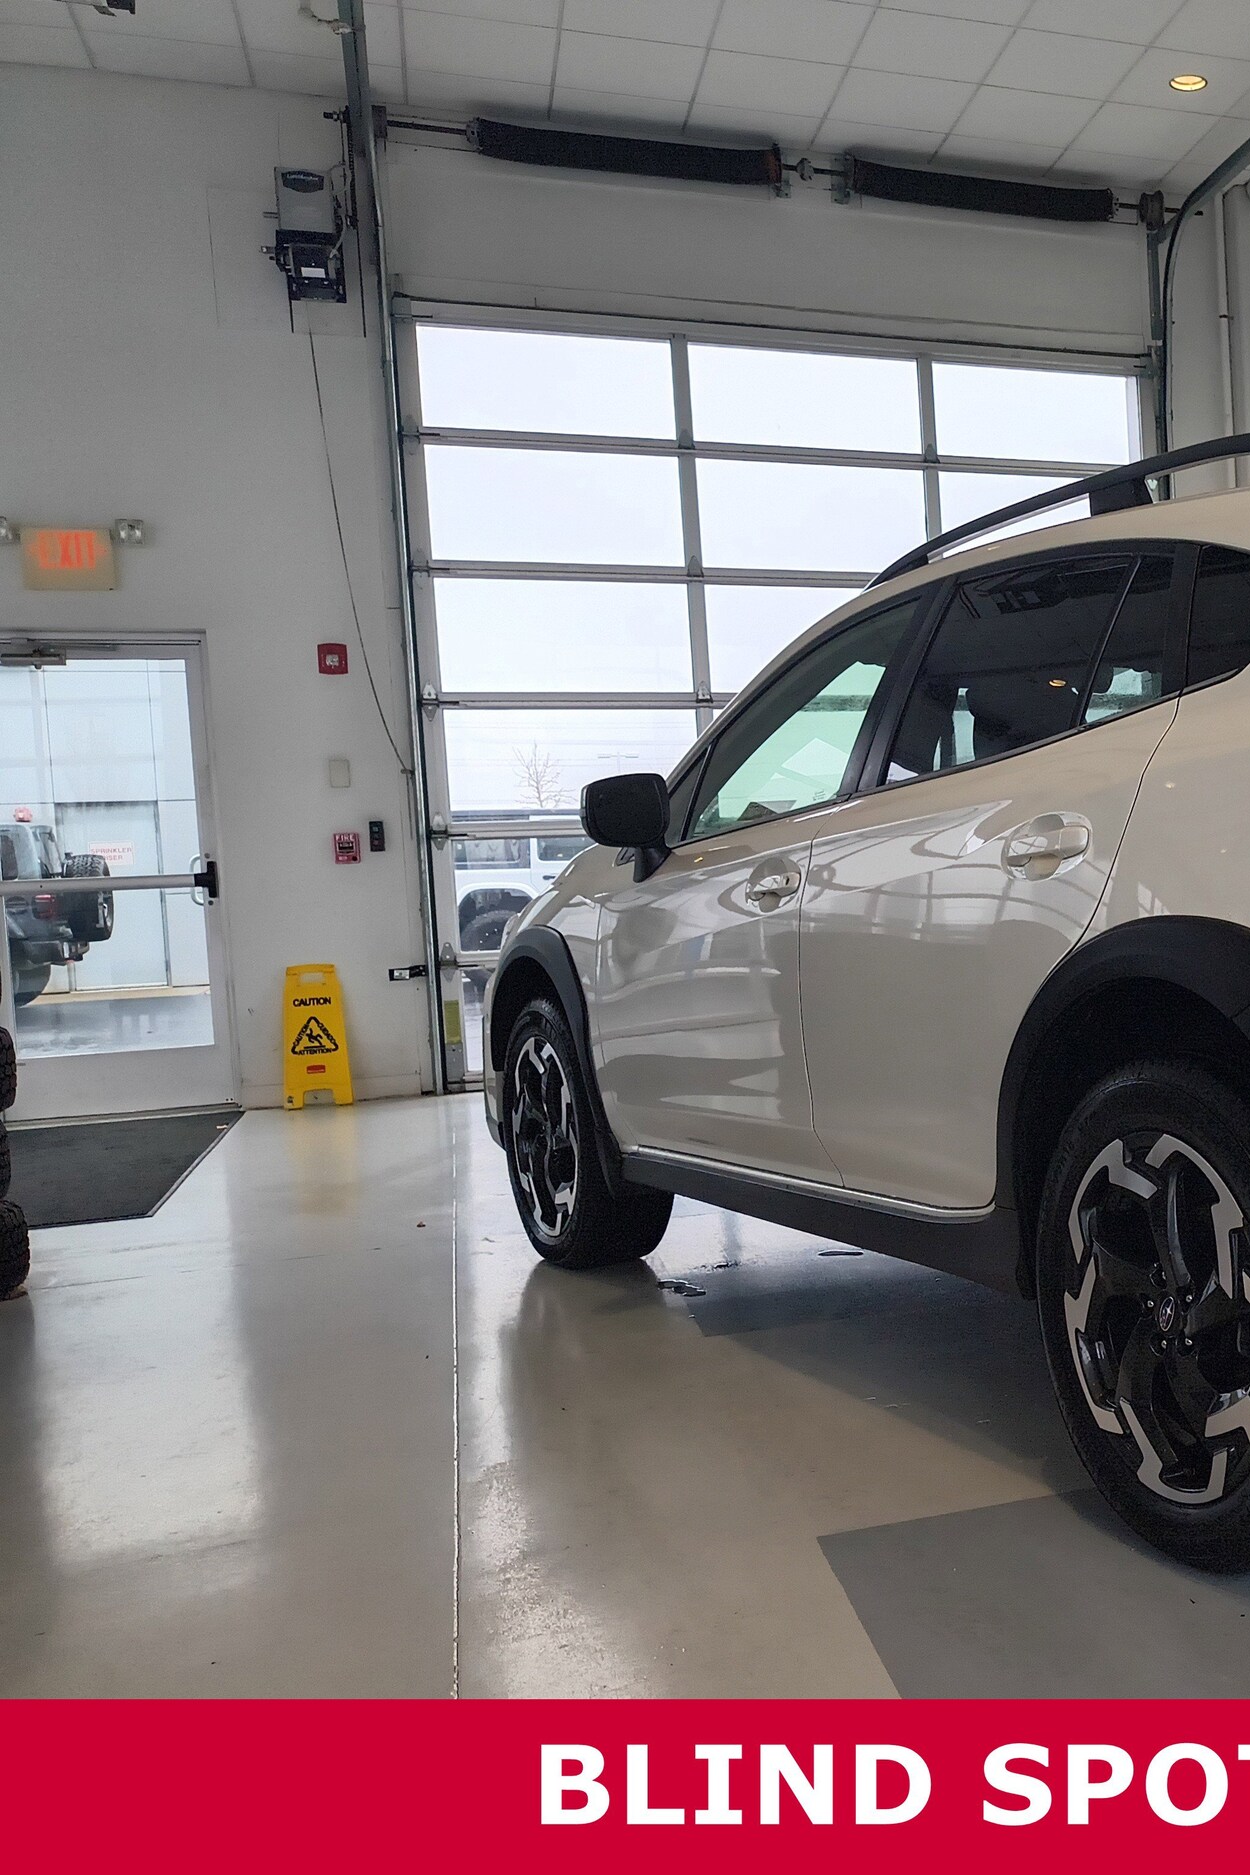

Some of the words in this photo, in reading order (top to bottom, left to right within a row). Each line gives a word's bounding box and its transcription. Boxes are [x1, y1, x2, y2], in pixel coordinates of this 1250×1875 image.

[38, 531, 96, 571] EXIT
[292, 997, 332, 1007] CAUTION
[293, 1023, 309, 1047] CAUTION
